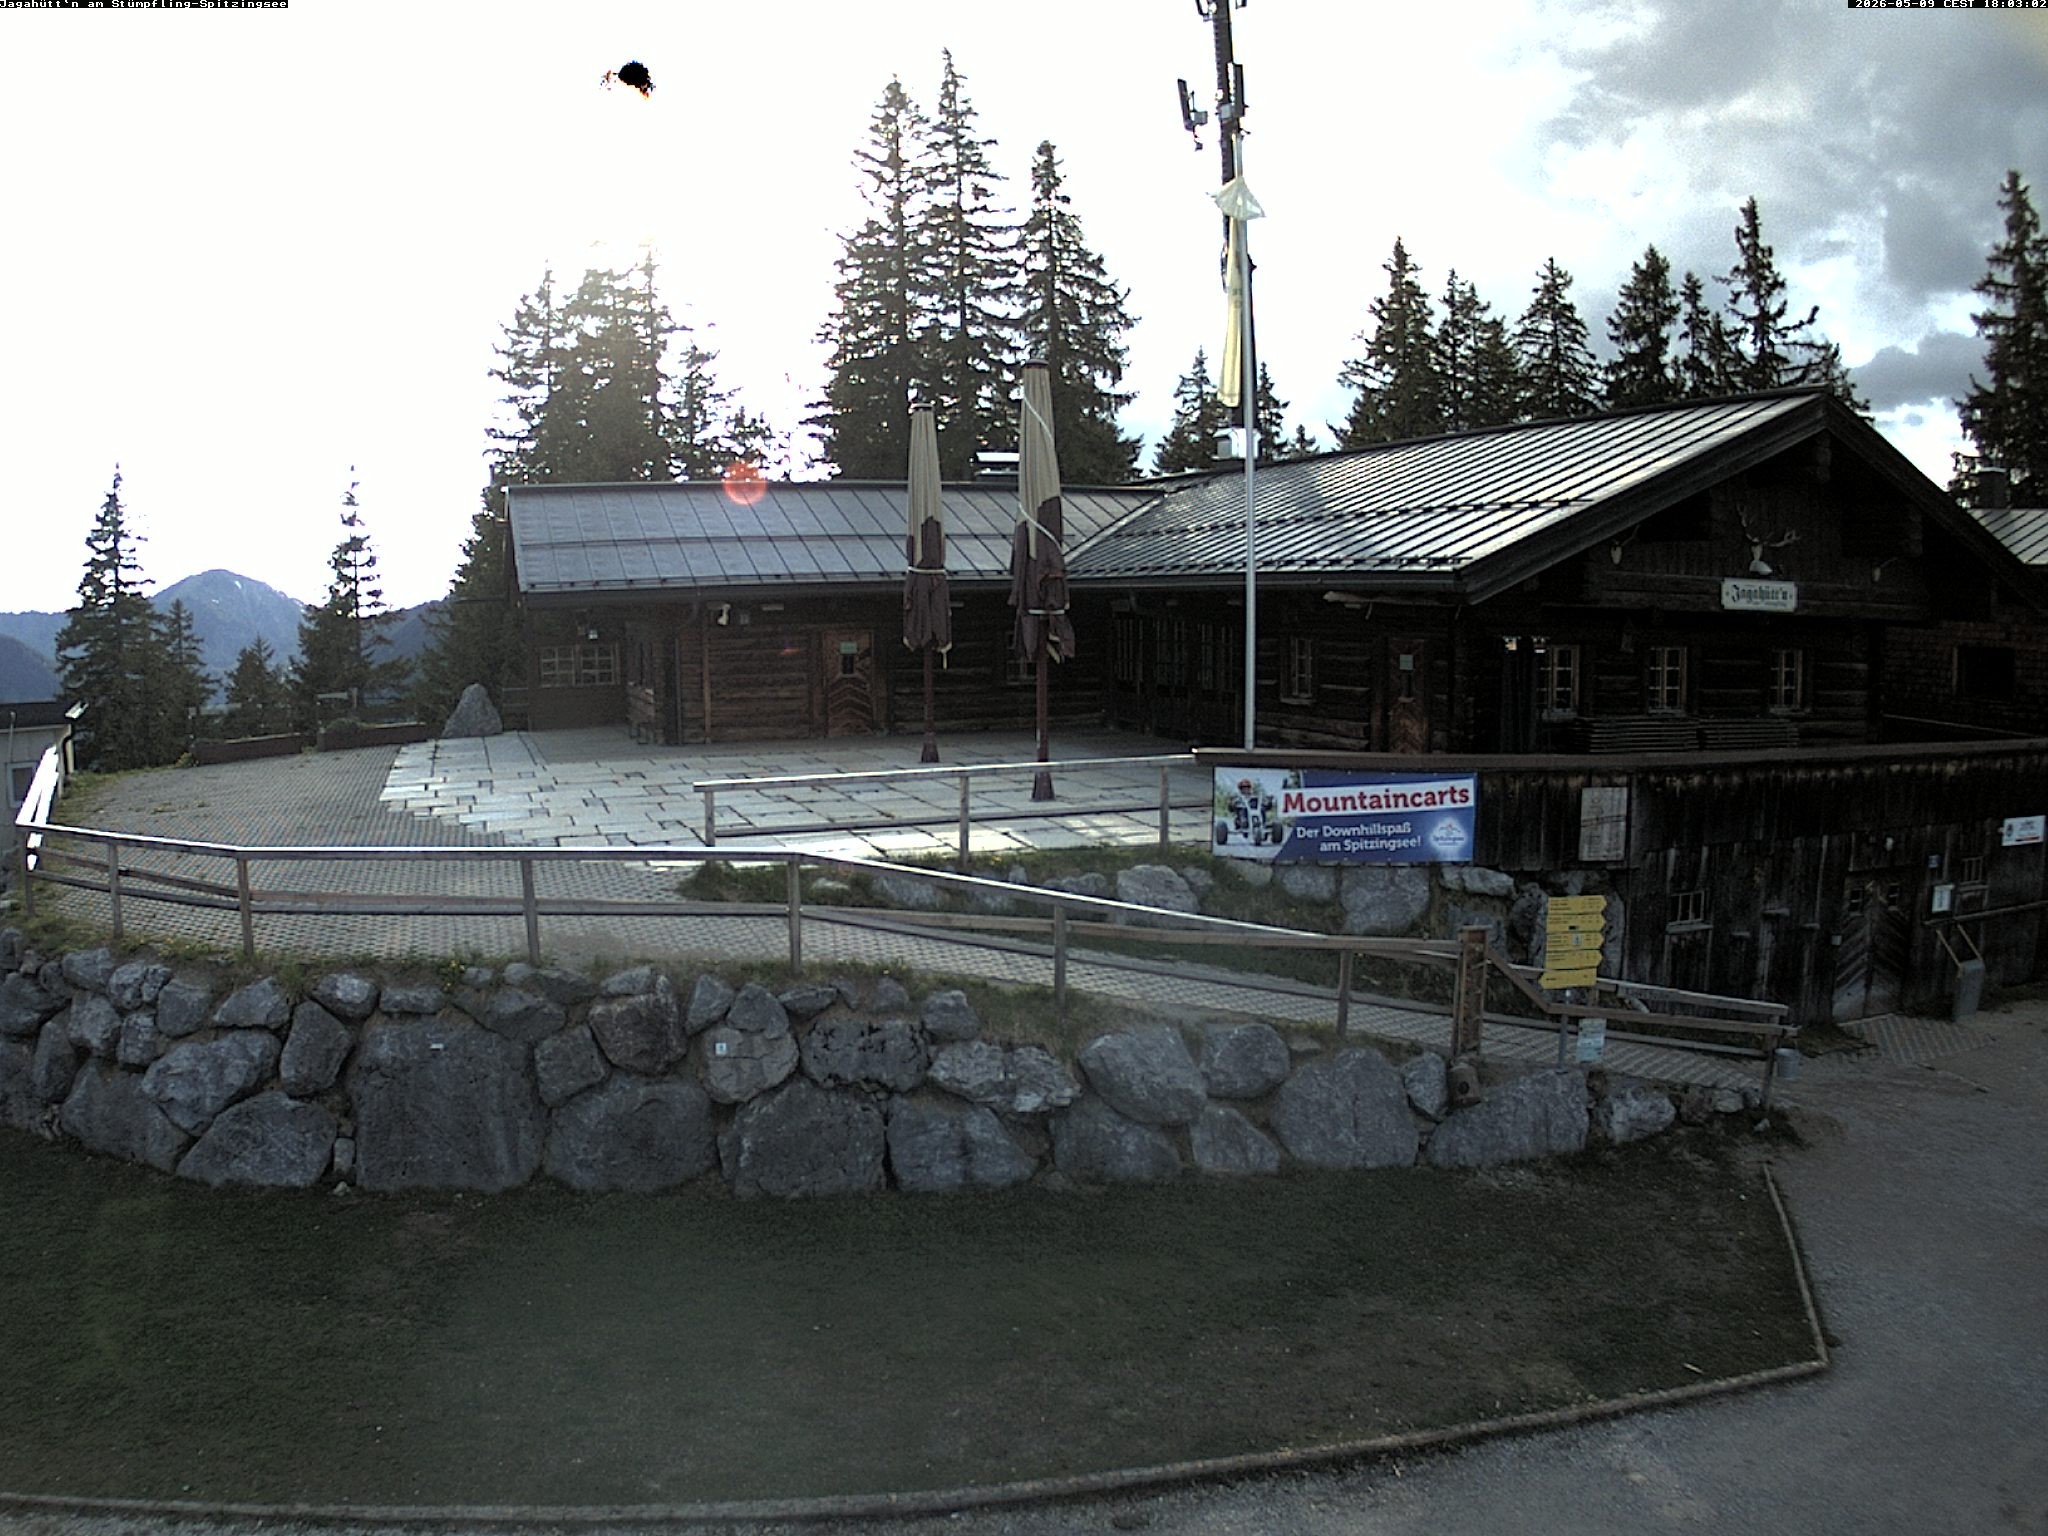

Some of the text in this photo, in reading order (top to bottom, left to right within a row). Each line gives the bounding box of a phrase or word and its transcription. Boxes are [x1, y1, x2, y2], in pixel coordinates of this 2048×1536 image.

[1283, 786, 1469, 813] Mountaincarts
[1296, 821, 1411, 838] Der Downhillspaß
[1320, 841, 1341, 852] am
[1343, 835, 1421, 853] Spitzingsee!
